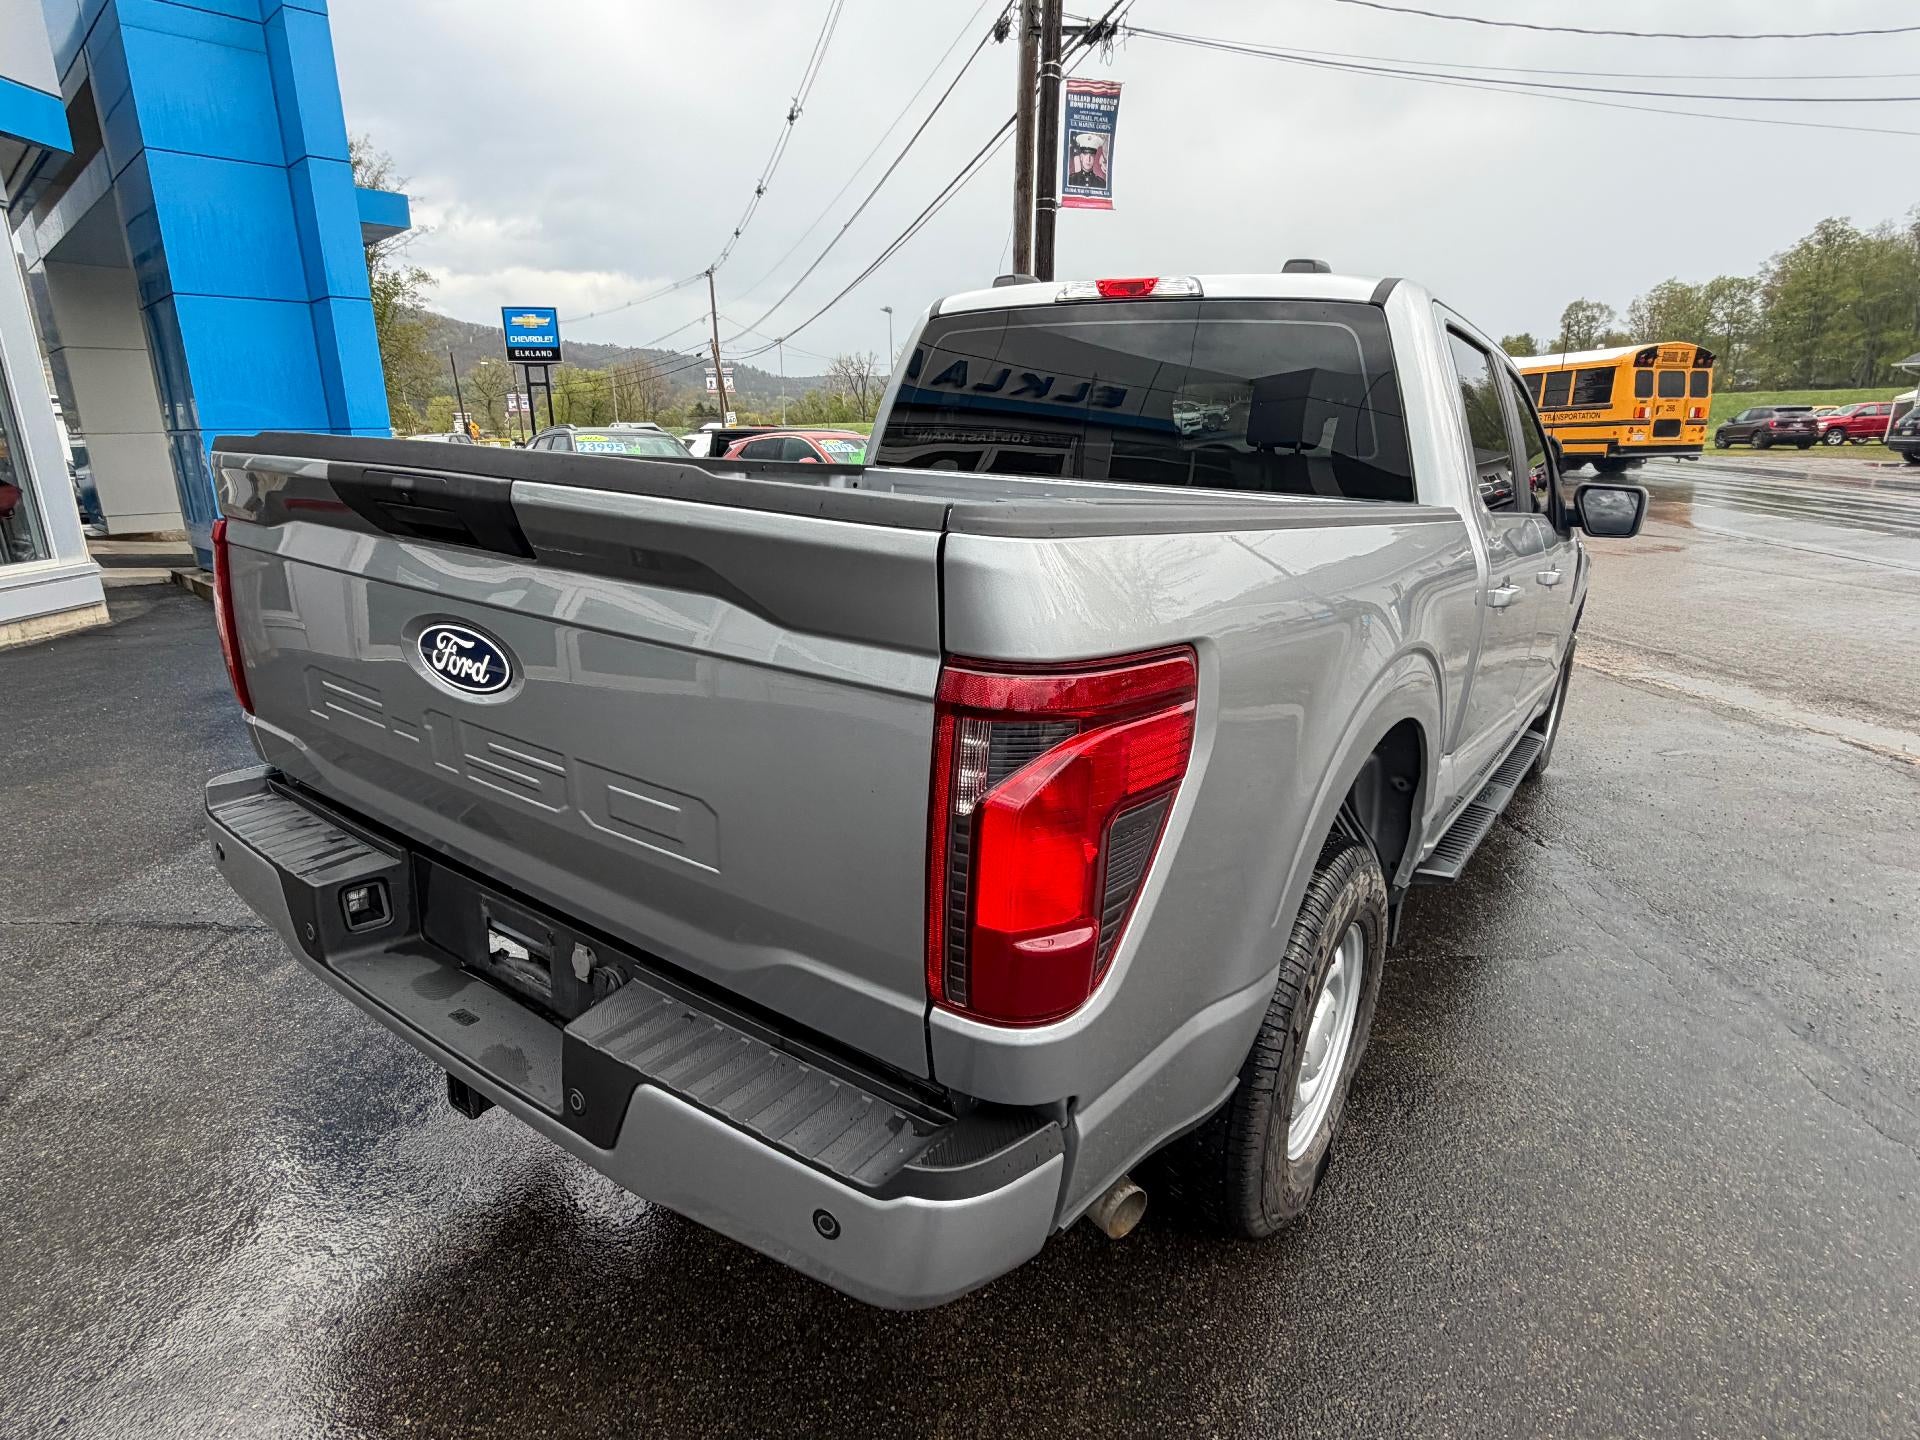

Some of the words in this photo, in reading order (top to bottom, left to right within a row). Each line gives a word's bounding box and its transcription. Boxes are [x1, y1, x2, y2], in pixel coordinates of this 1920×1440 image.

[510, 335, 554, 343] CHEVROLET
[1543, 412, 1601, 422] TRANSPORTATION
[579, 442, 624, 452] 23995
[432, 631, 490, 685] Ford
[304, 665, 721, 874] F-150
